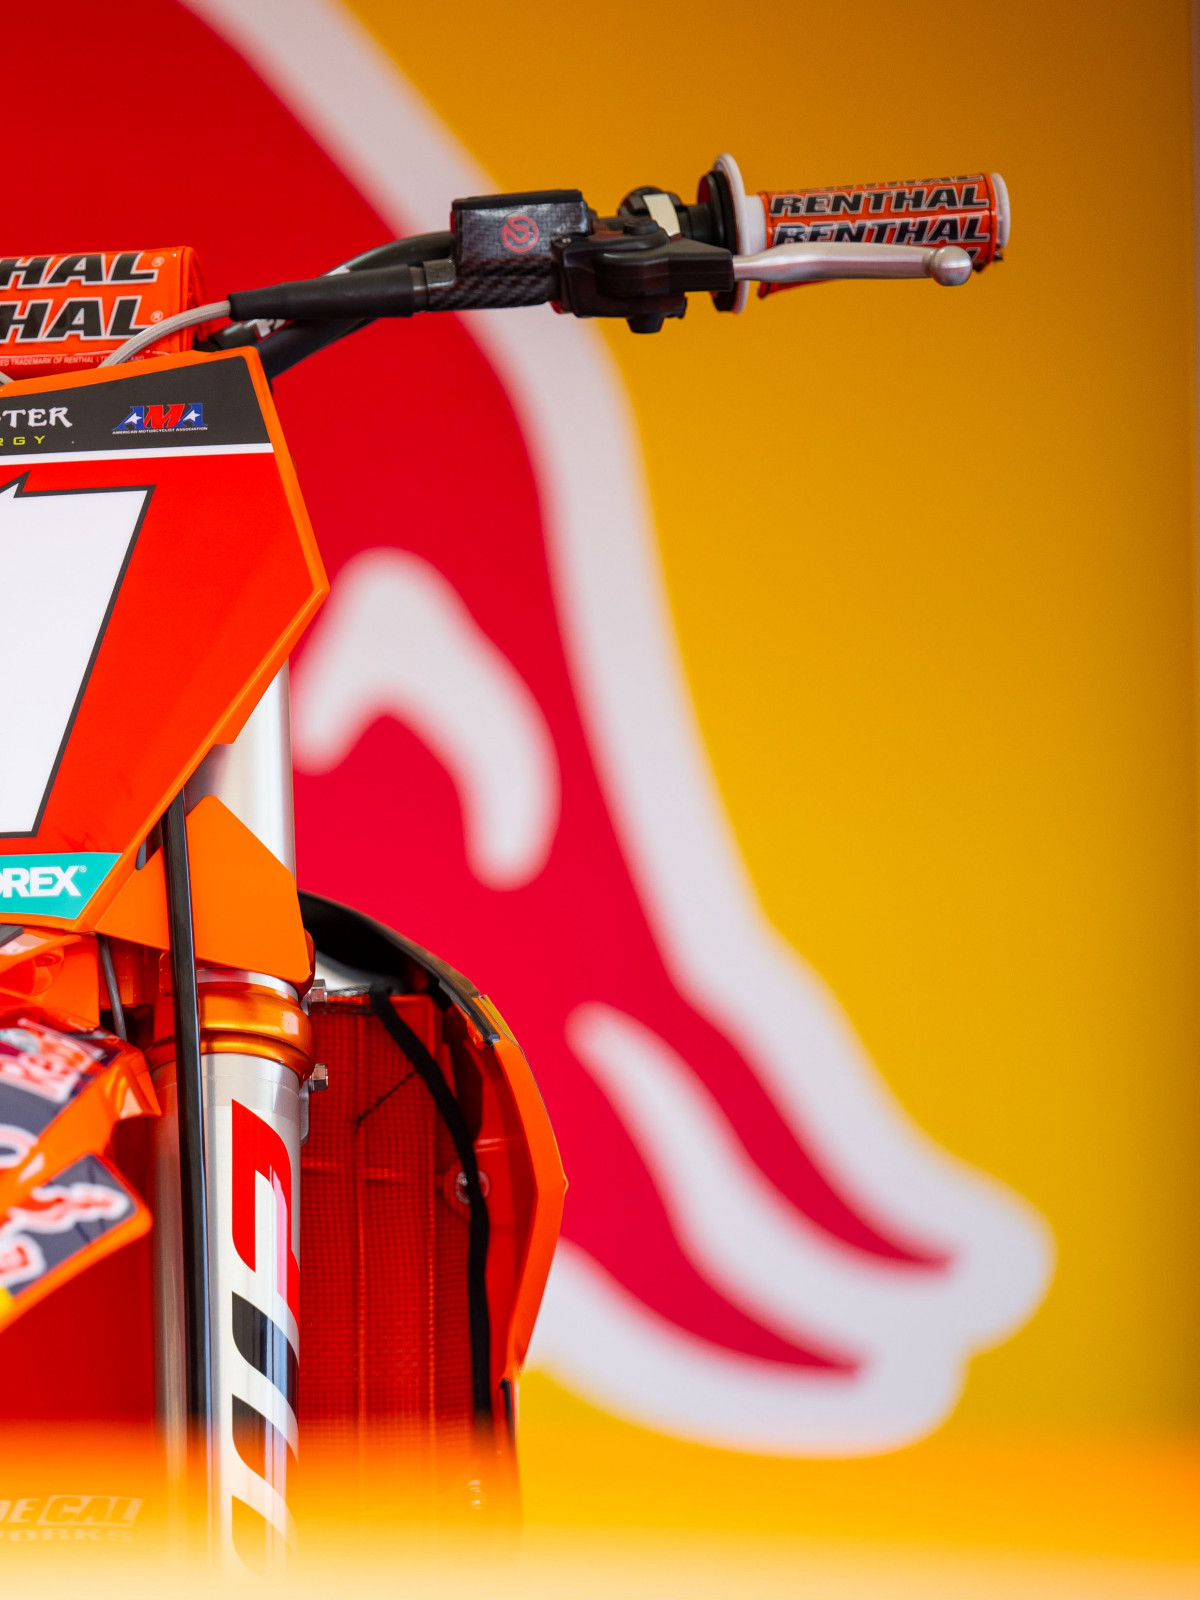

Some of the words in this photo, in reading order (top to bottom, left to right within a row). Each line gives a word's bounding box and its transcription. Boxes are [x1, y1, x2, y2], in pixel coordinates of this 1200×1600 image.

[770, 184, 990, 217] RENTHAL
[773, 215, 991, 245] RENTHAL
[11, 357, 52, 366] TRADEMARK
[52, 356, 63, 365] OF
[64, 355, 94, 364] RENTHAL
[112, 403, 208, 430] AMA
